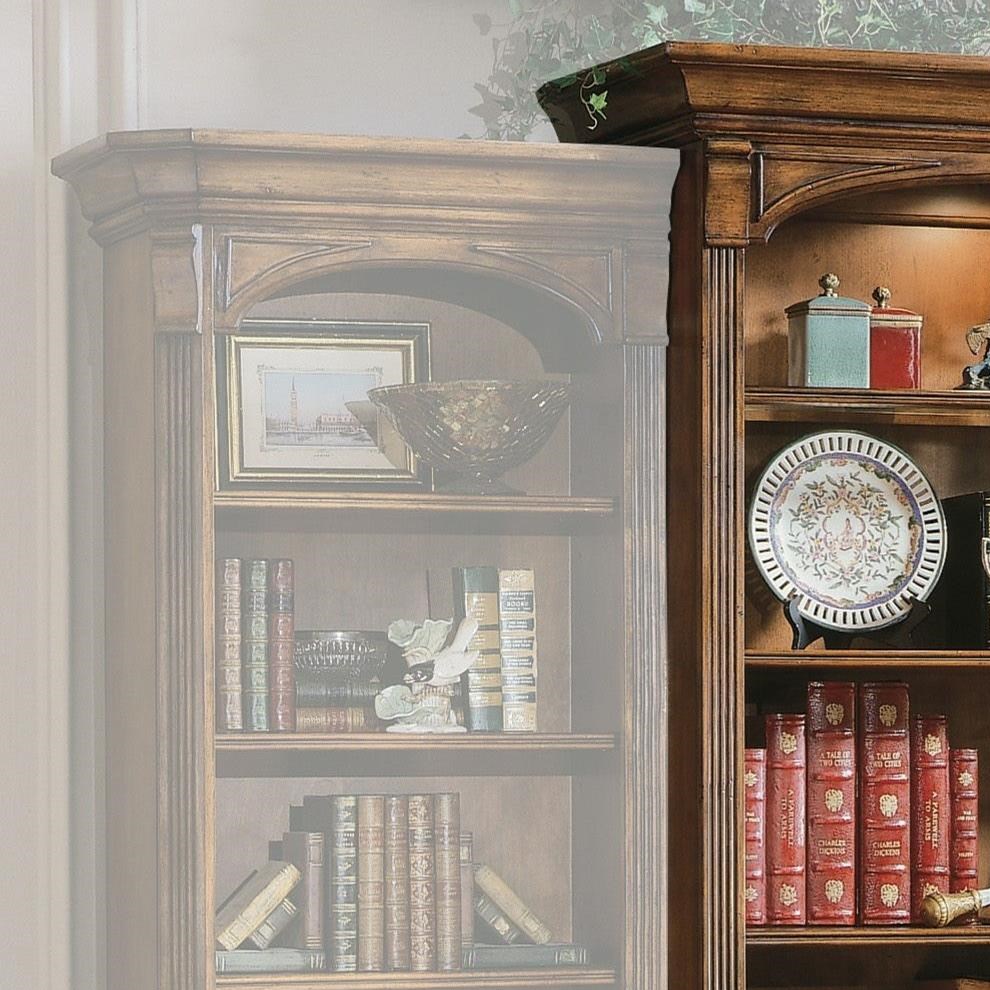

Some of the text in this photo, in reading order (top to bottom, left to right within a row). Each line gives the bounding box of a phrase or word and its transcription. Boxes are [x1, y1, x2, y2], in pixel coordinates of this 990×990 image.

[827, 751, 841, 759] TALE
[842, 751, 851, 759] OF
[876, 752, 901, 760] TALE OF
[925, 799, 931, 812] TO
